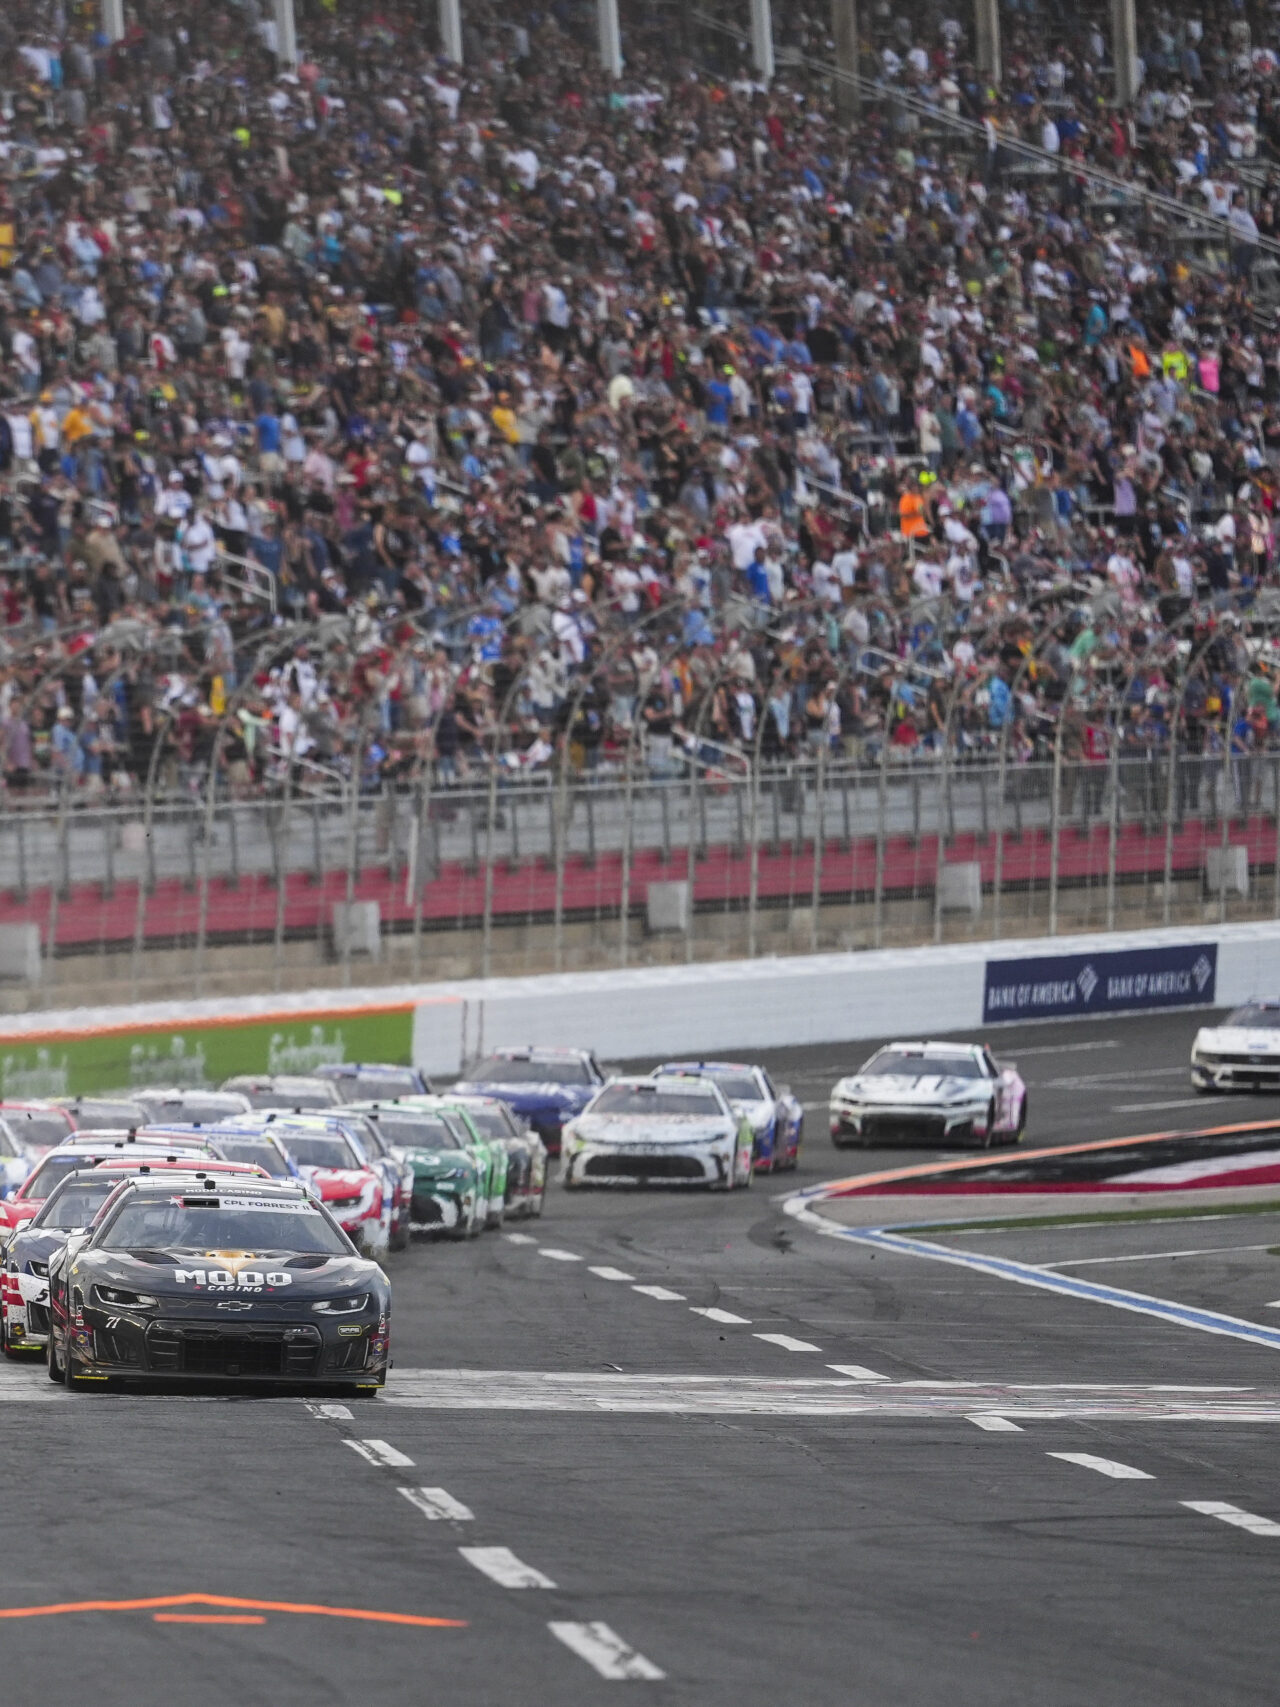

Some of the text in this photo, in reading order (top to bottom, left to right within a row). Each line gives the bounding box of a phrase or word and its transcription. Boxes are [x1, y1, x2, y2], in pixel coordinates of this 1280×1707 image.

[247, 1201, 300, 1210] FORREST
[173, 1269, 292, 1287] MODO
[207, 1285, 263, 1293] CASINO
[105, 1316, 121, 1329] 71
